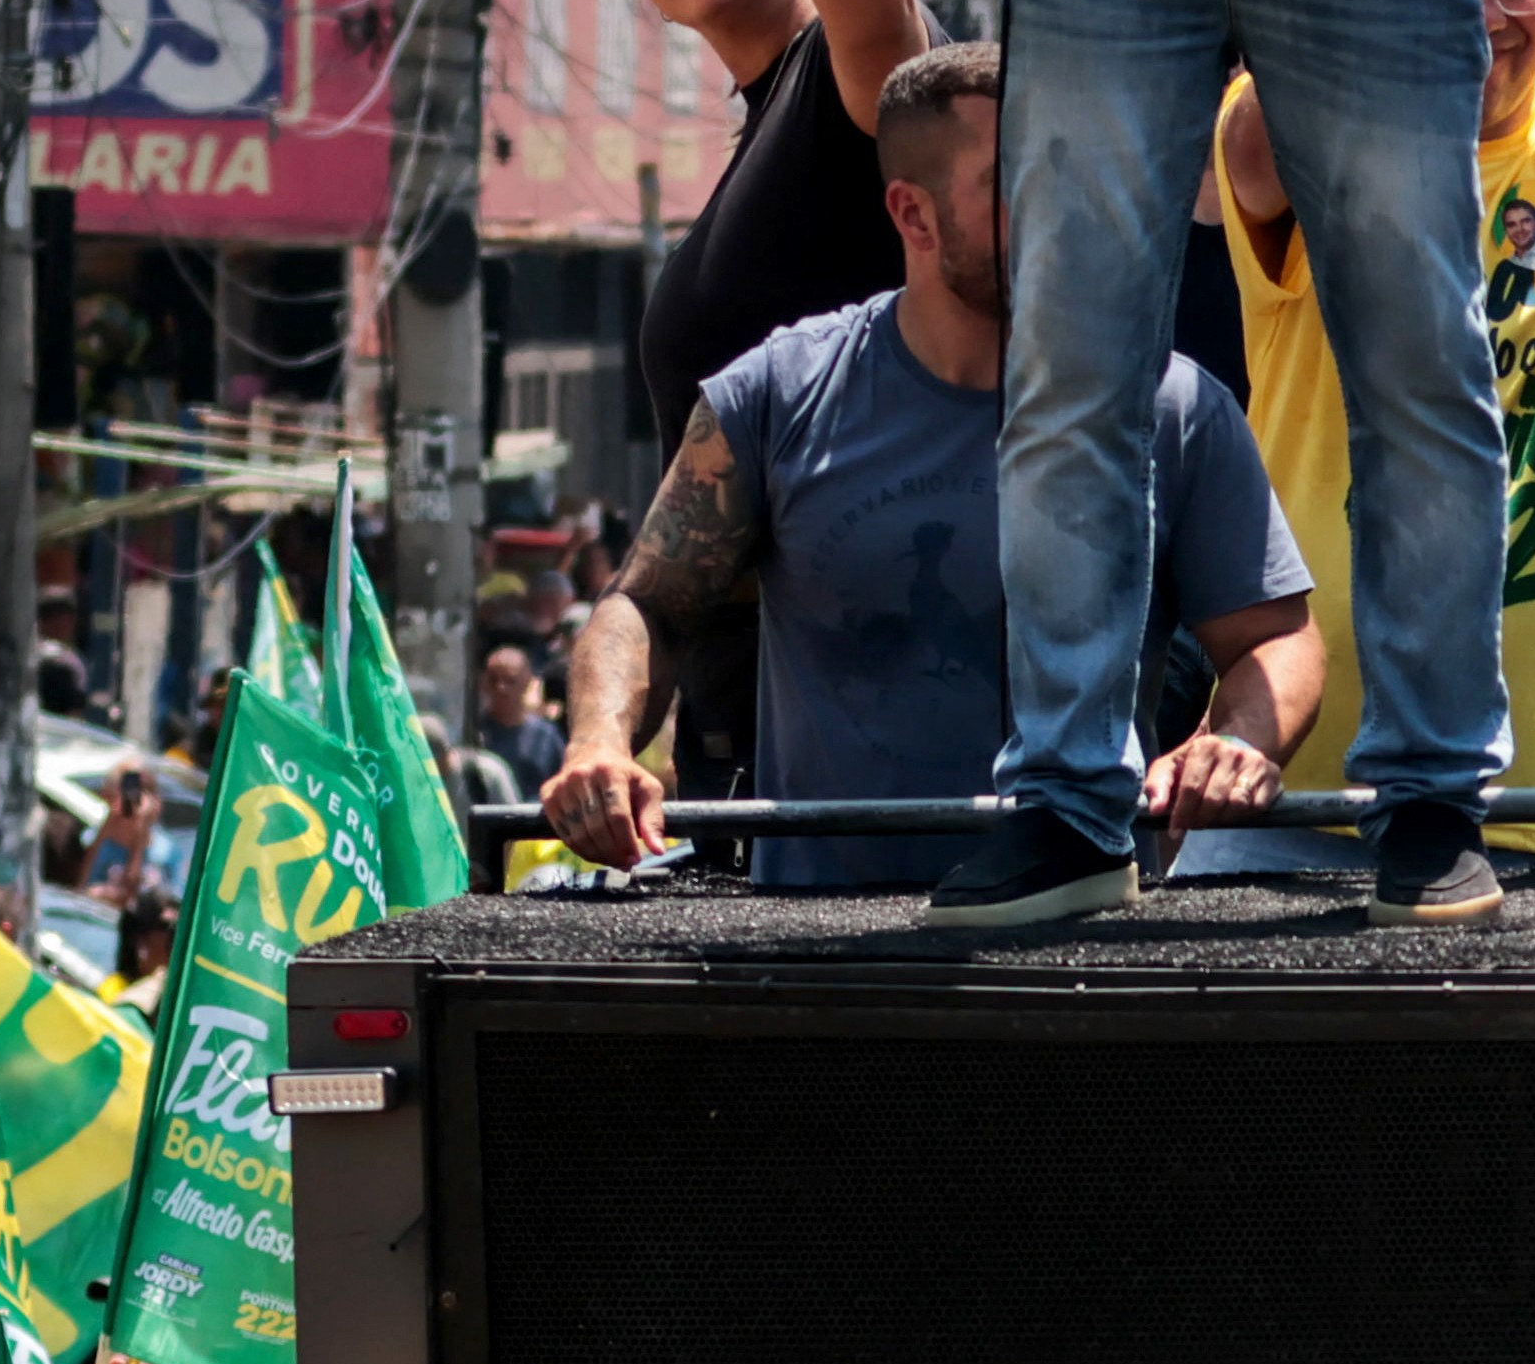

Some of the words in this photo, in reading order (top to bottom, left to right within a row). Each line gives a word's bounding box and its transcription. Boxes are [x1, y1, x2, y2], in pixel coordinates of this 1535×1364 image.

[210, 914, 245, 947] Vice
[161, 1117, 293, 1207] Bolson
[161, 1178, 245, 1241] Alfredo
[244, 1209, 295, 1265] Gasp
[133, 1260, 206, 1299] JORDY
